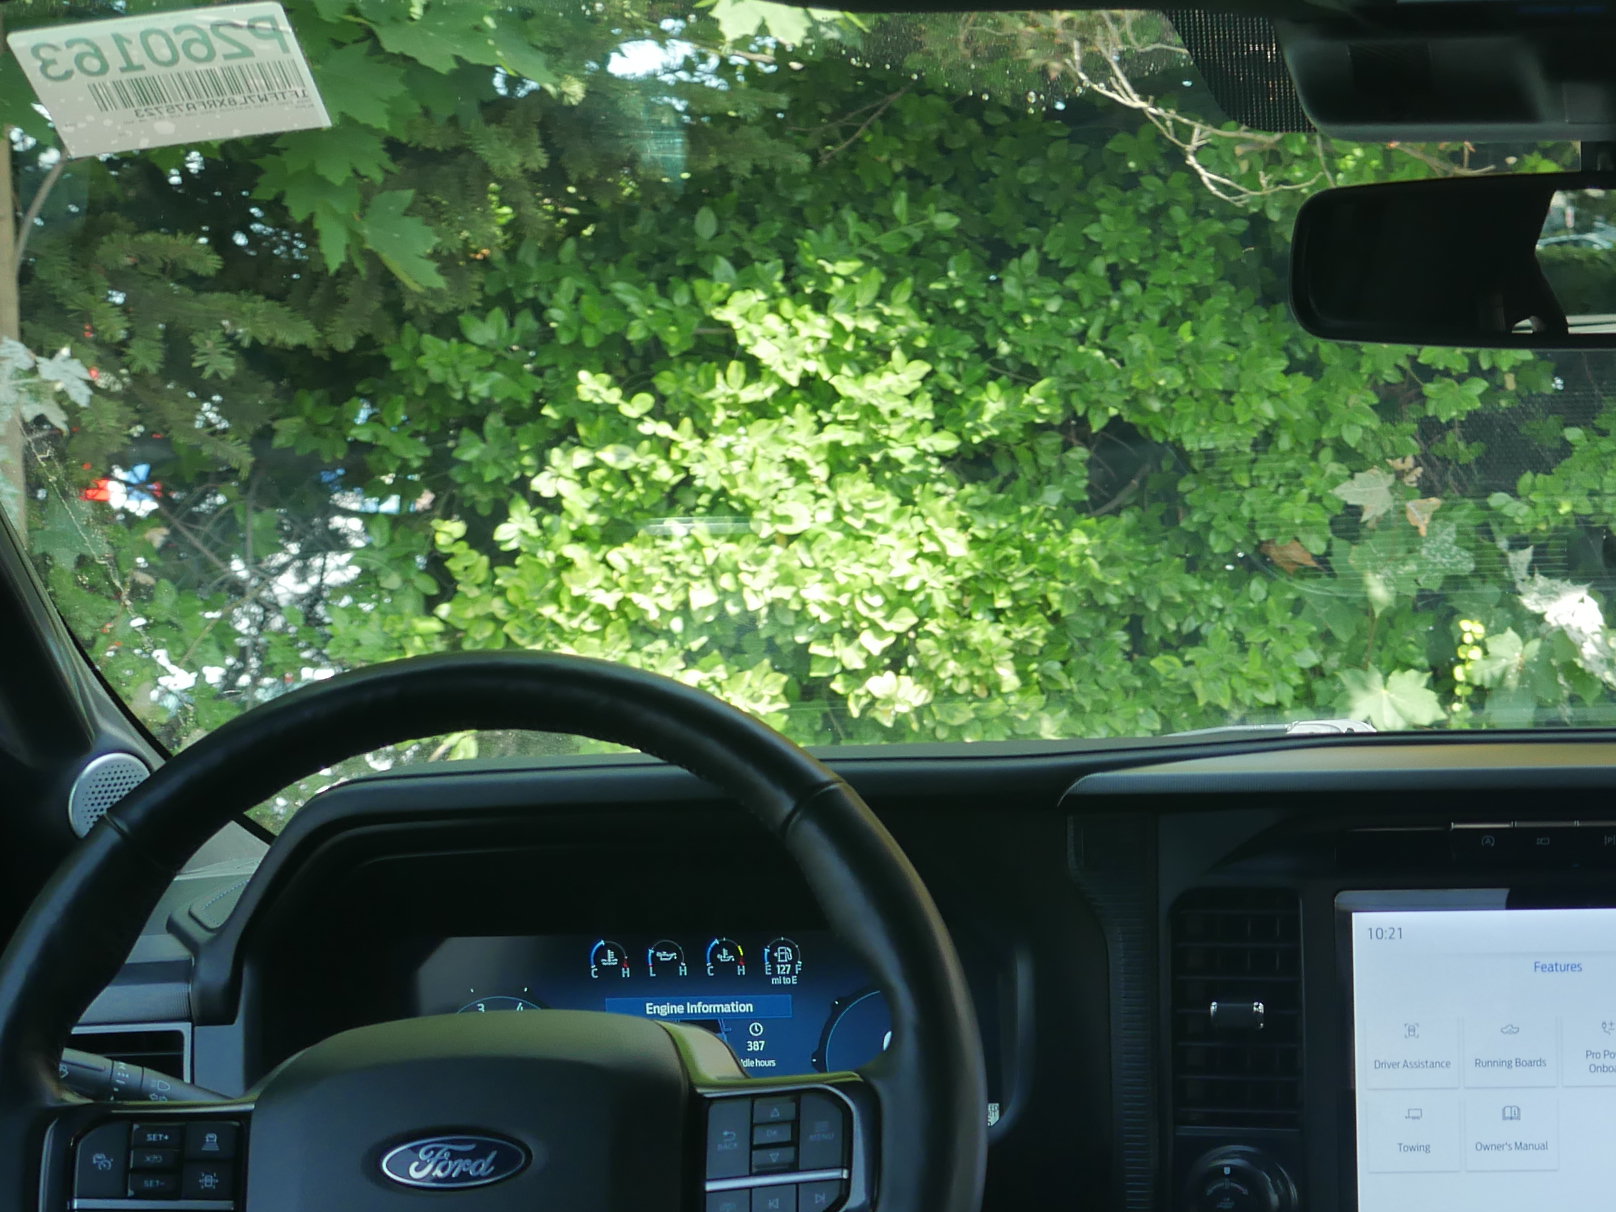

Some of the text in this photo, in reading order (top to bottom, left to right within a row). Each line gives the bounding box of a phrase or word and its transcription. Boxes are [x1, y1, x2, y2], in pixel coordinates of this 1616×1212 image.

[1367, 927, 1404, 940] 10:21
[621, 967, 630, 978] H
[649, 966, 657, 977] L
[678, 965, 688, 977] H
[706, 965, 715, 977] C
[737, 965, 746, 976] H
[764, 965, 772, 976] E
[776, 964, 792, 975] 127
[795, 964, 802, 975] F
[1533, 961, 1583, 973] Features
[590, 967, 599, 979] C
[771, 976, 798, 985] mi to E
[645, 1001, 754, 1017] Engine Information
[746, 1040, 766, 1051] 387
[1585, 1050, 1602, 1060] Pro
[754, 1057, 776, 1067] hours
[1373, 1059, 1452, 1070] Driver Assistance
[1474, 1057, 1547, 1070] Running Boards
[1397, 1142, 1431, 1155] Towing
[1475, 1140, 1549, 1152] Owner's Manual
[408, 1143, 498, 1180] Ford
